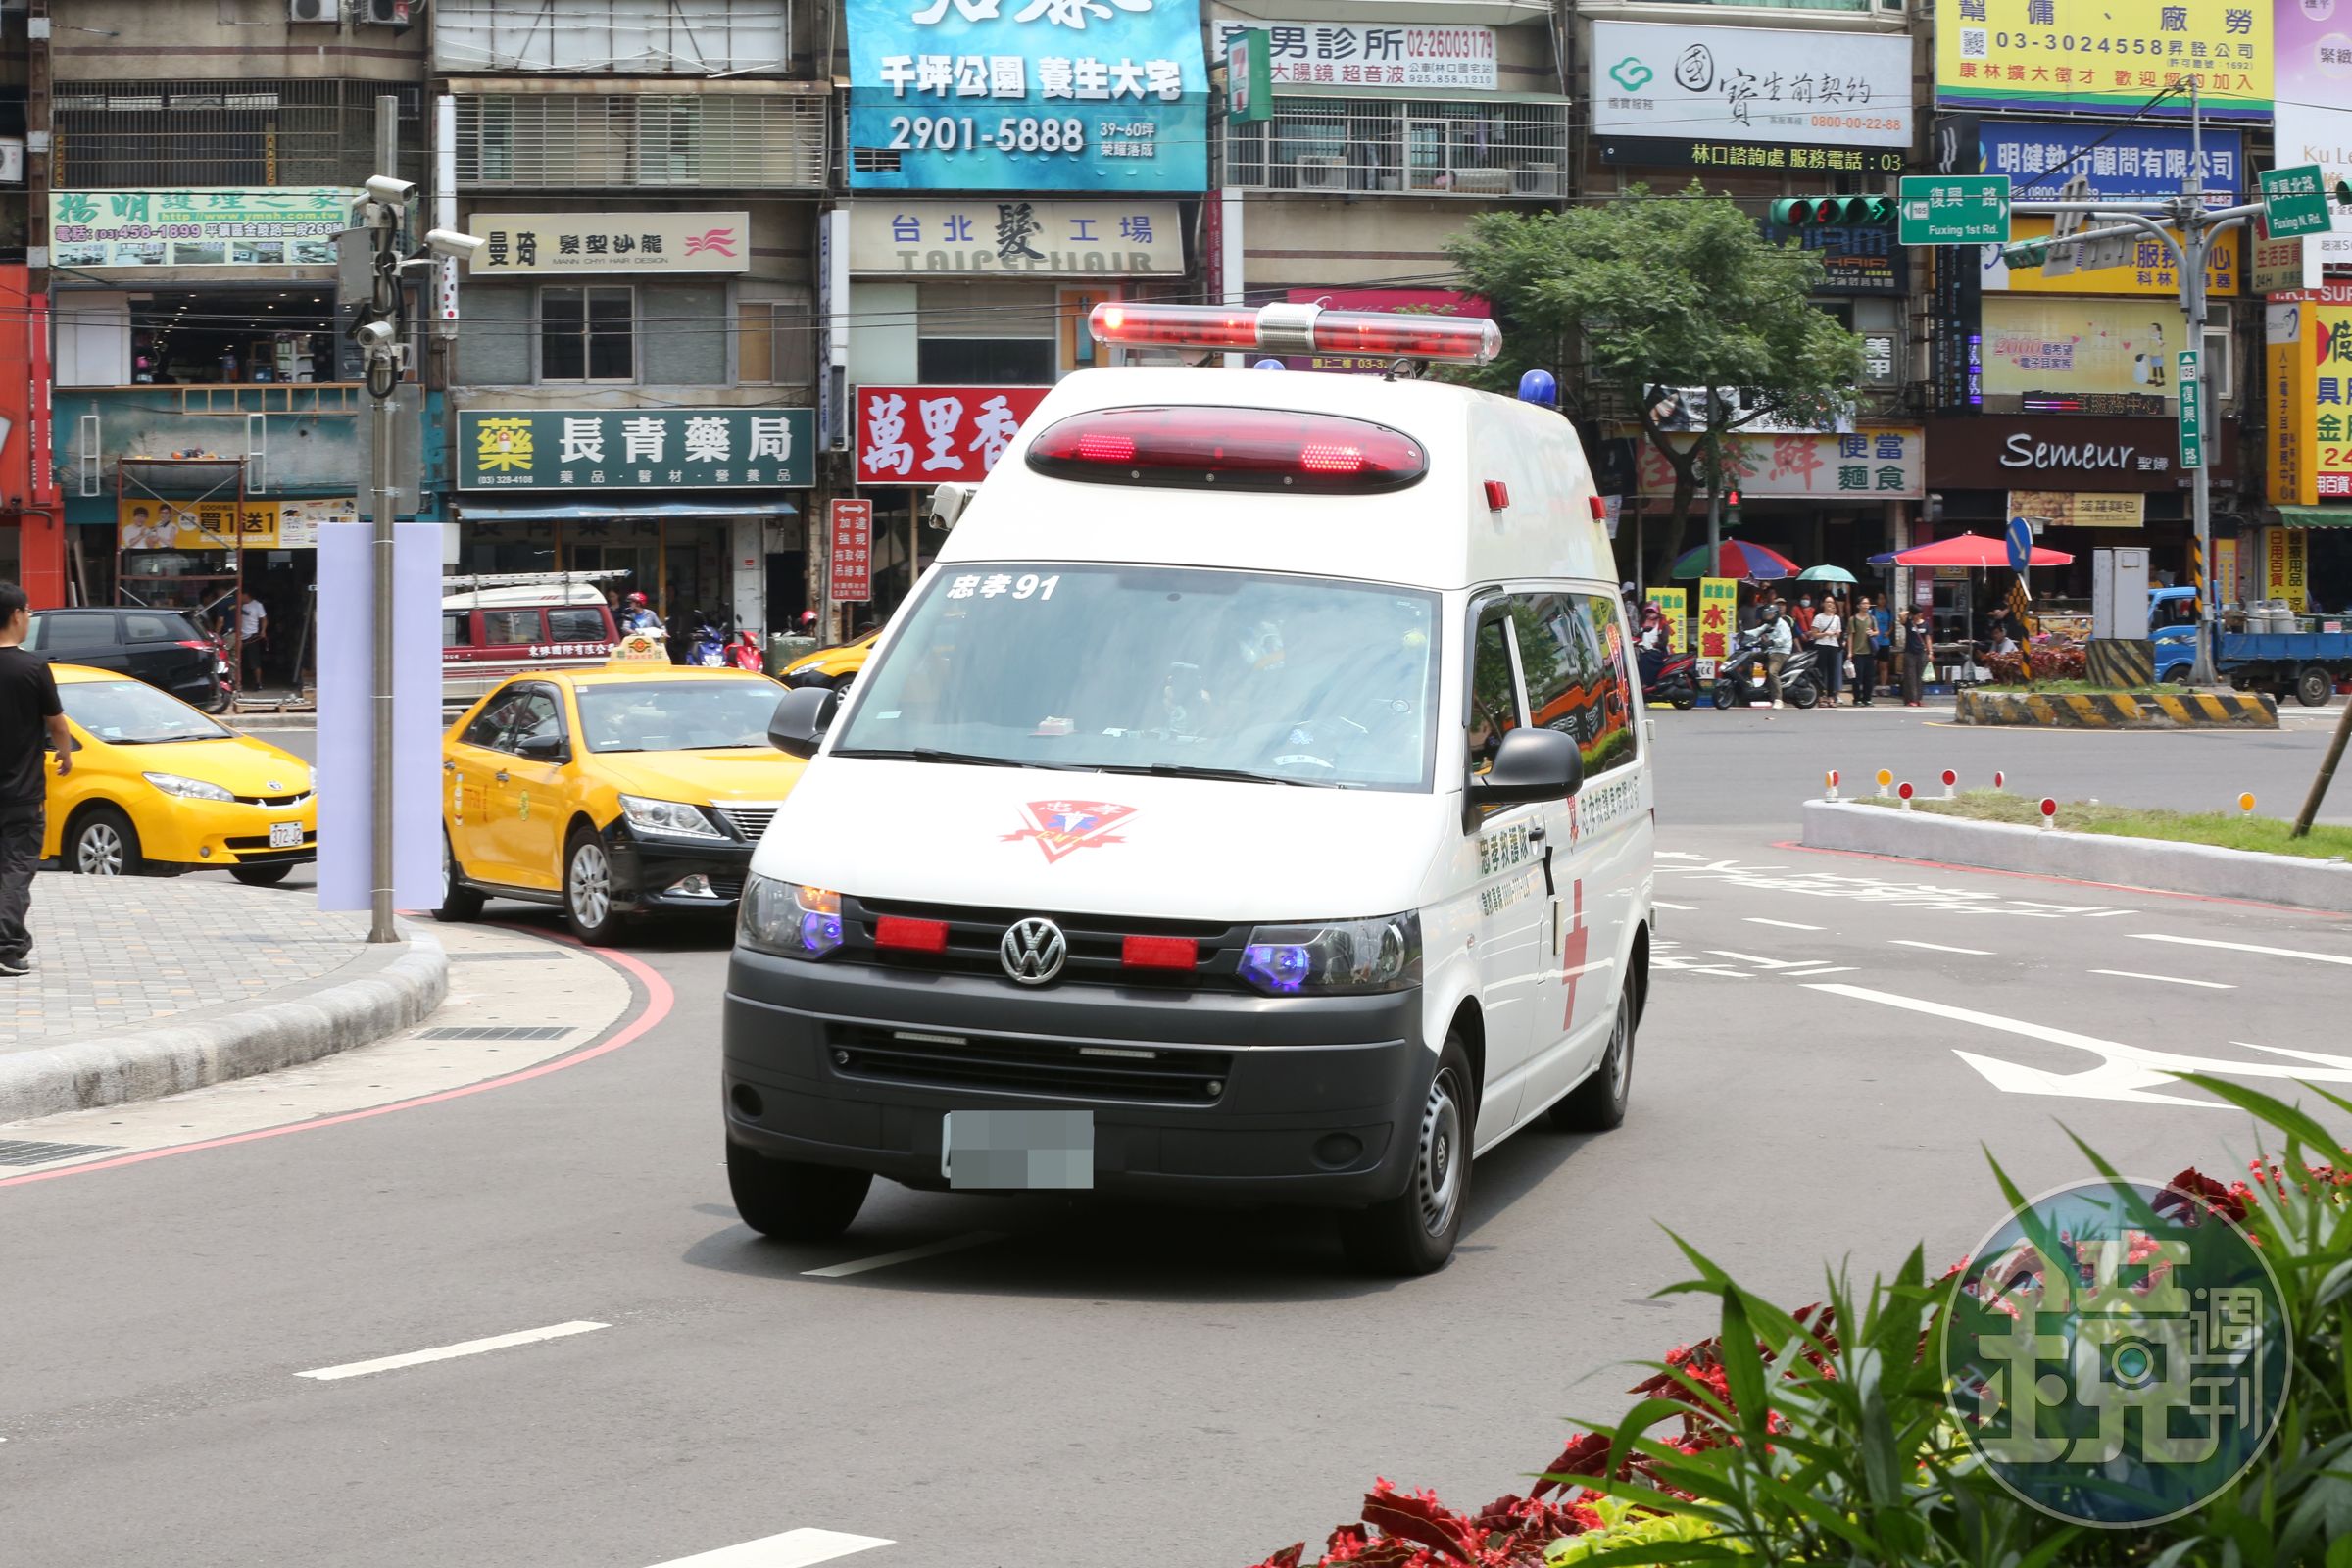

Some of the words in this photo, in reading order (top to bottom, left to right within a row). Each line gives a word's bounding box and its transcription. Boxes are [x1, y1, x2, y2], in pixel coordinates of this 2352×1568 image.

[1407, 30, 1493, 59] 02-26003179
[1996, 32, 2163, 55] 03-3024558
[880, 55, 1027, 99] 千坪公園
[1037, 57, 1182, 101] 養生大宅
[1341, 63, 1405, 84] 超音波
[888, 117, 1084, 152] 2901-5888
[1810, 115, 1902, 131] 0800-00-22-88
[1690, 143, 1786, 168] 林口諮詢處
[1929, 187, 1998, 209] 復興一路
[2267, 175, 2316, 202] 復興北路
[1928, 223, 1963, 238] Fuxing
[1965, 223, 1983, 235] 1st
[1984, 223, 1999, 236] Rd.
[2273, 218, 2299, 230] Fuxing
[2309, 213, 2323, 225] Rd.
[559, 234, 662, 255] 髮型沙龍
[861, 393, 1021, 476] 萬里香
[2181, 385, 2197, 465] 復興一路
[476, 417, 534, 472] 藥
[559, 416, 793, 465] 長青藥局
[1838, 431, 1905, 461] 便當
[1999, 432, 2135, 470] Semeur
[1838, 465, 1906, 491] 麵食
